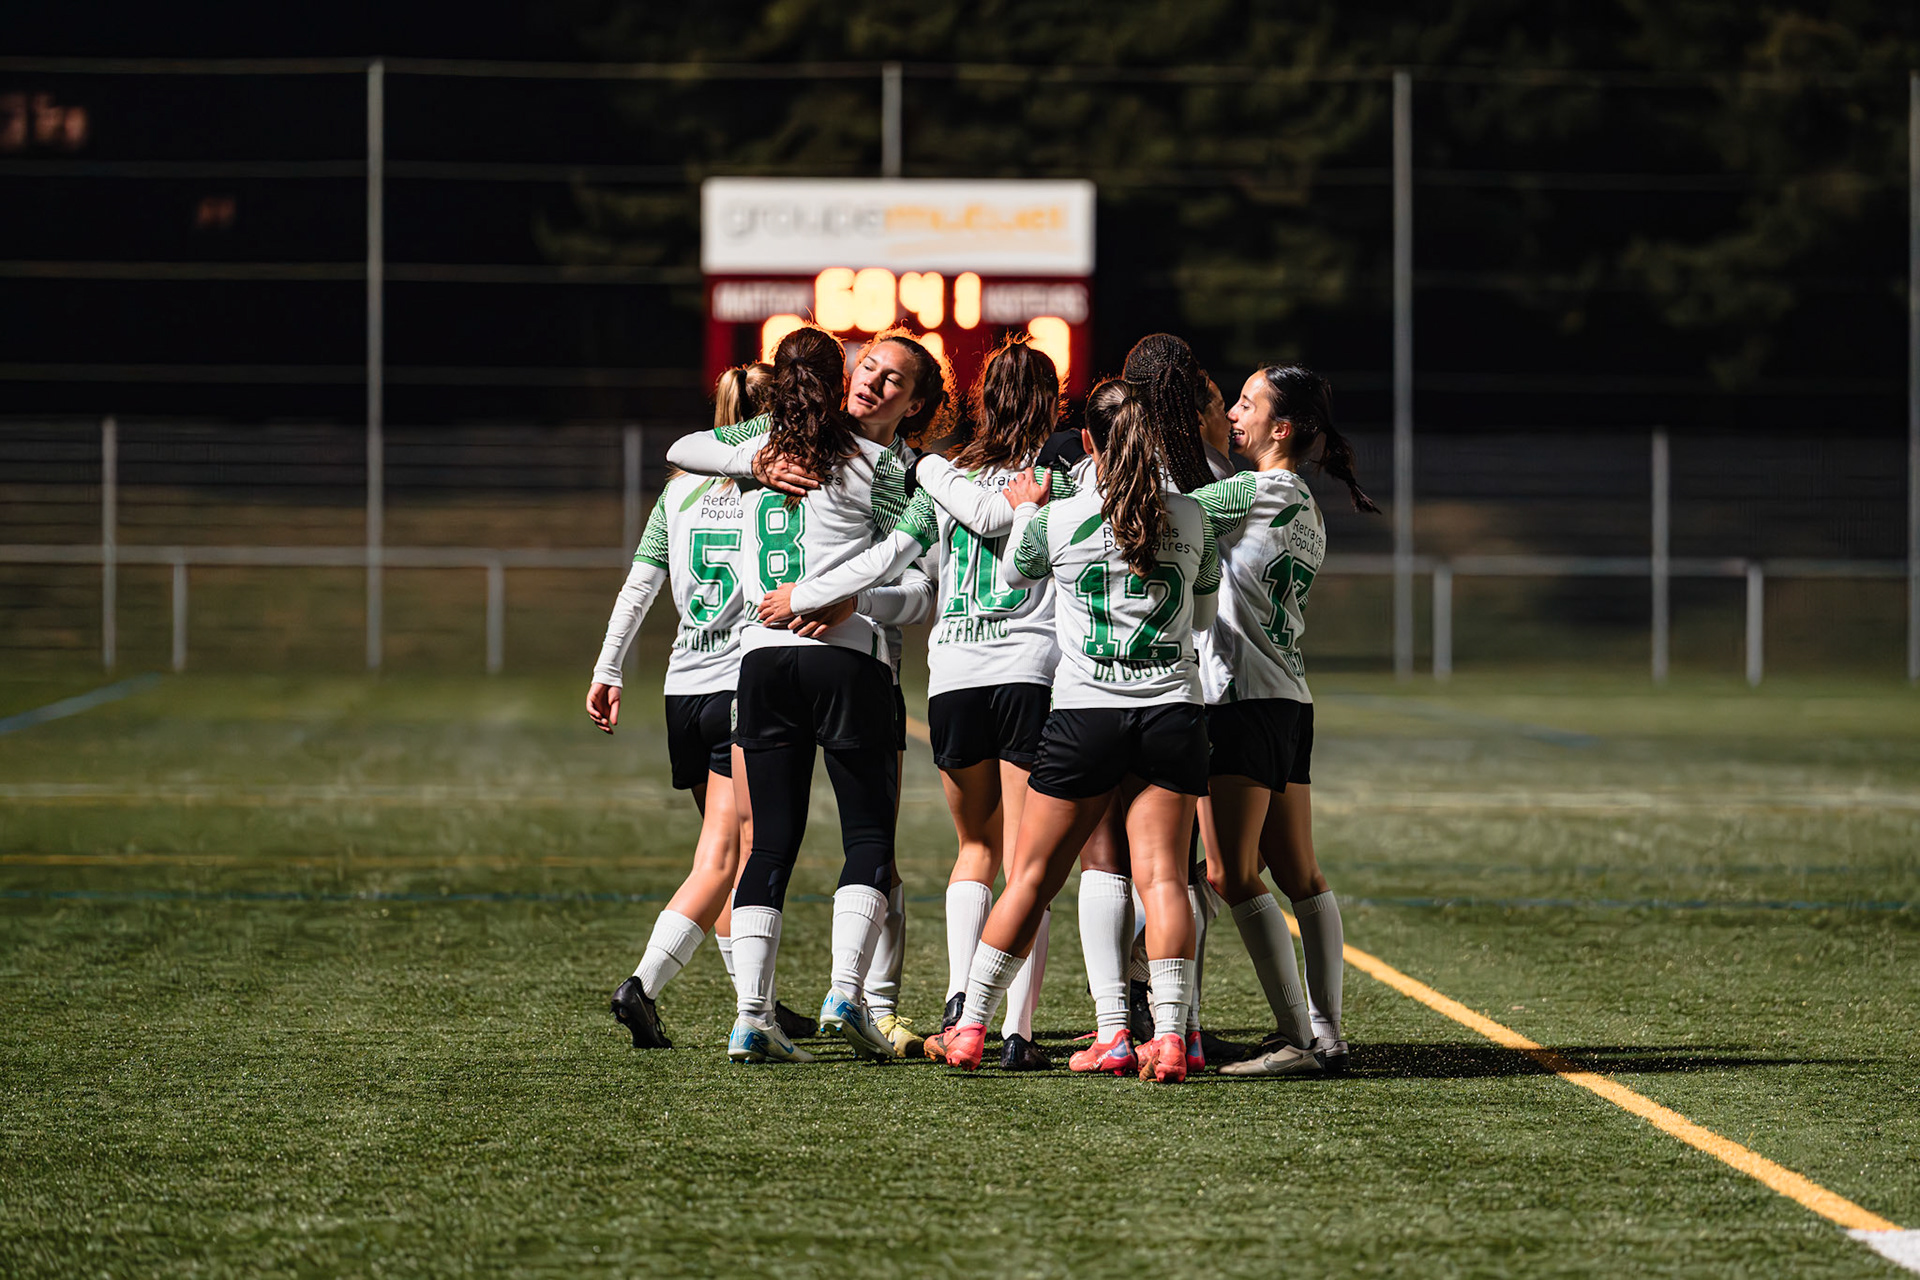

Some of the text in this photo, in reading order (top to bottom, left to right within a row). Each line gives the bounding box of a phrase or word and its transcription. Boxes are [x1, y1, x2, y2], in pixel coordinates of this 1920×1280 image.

[688, 528, 743, 626] 5
[755, 490, 806, 594] 8
[1075, 560, 1186, 661] 12
